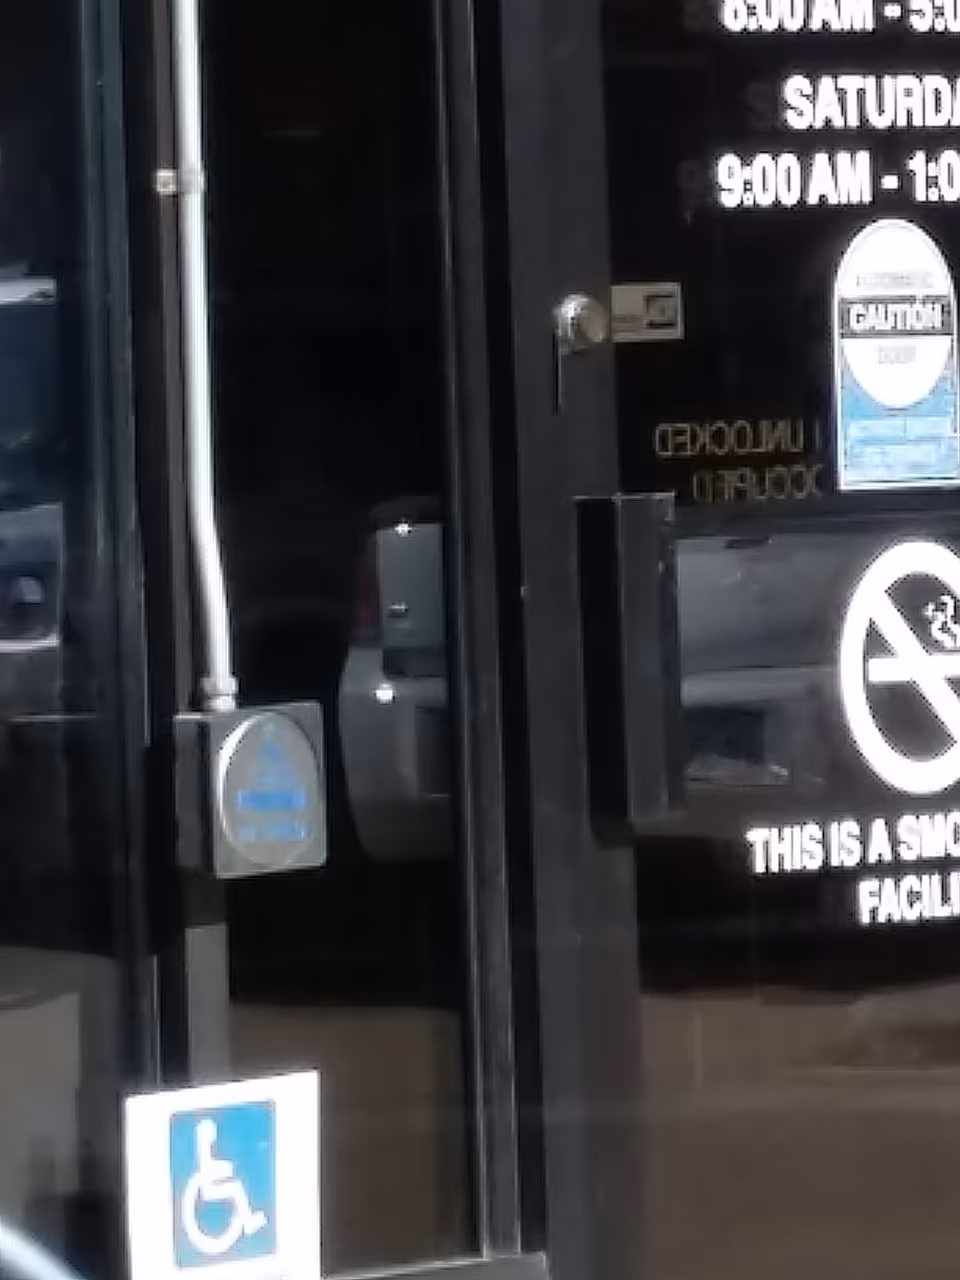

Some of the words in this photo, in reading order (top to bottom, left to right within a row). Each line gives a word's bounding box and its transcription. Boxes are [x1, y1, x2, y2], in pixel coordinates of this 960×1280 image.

[716, 151, 802, 208] 9:00
[807, 150, 873, 205] AM
[849, 301, 944, 331] CAUTION
[746, 823, 823, 873] THIS
[829, 819, 862, 867] IS
[868, 818, 893, 864] A
